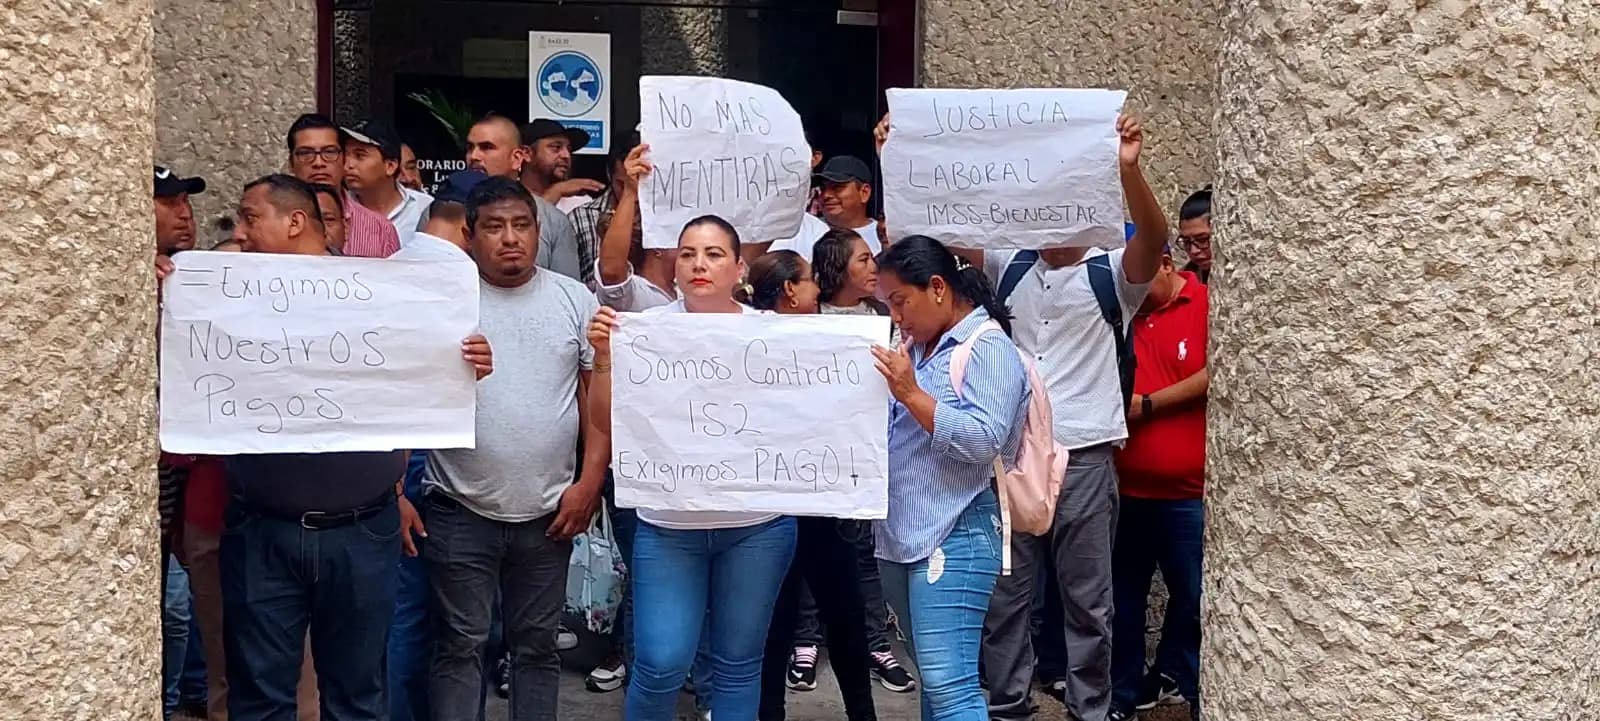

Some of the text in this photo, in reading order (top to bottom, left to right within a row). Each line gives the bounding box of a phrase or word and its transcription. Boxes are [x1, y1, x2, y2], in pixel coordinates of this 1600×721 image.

[715, 97, 771, 135] MAS
[416, 159, 466, 170] ORARIO
[652, 146, 801, 214] MENTIRAS
[628, 335, 861, 386] Somos Contrato
[618, 449, 738, 493] Exigimos
